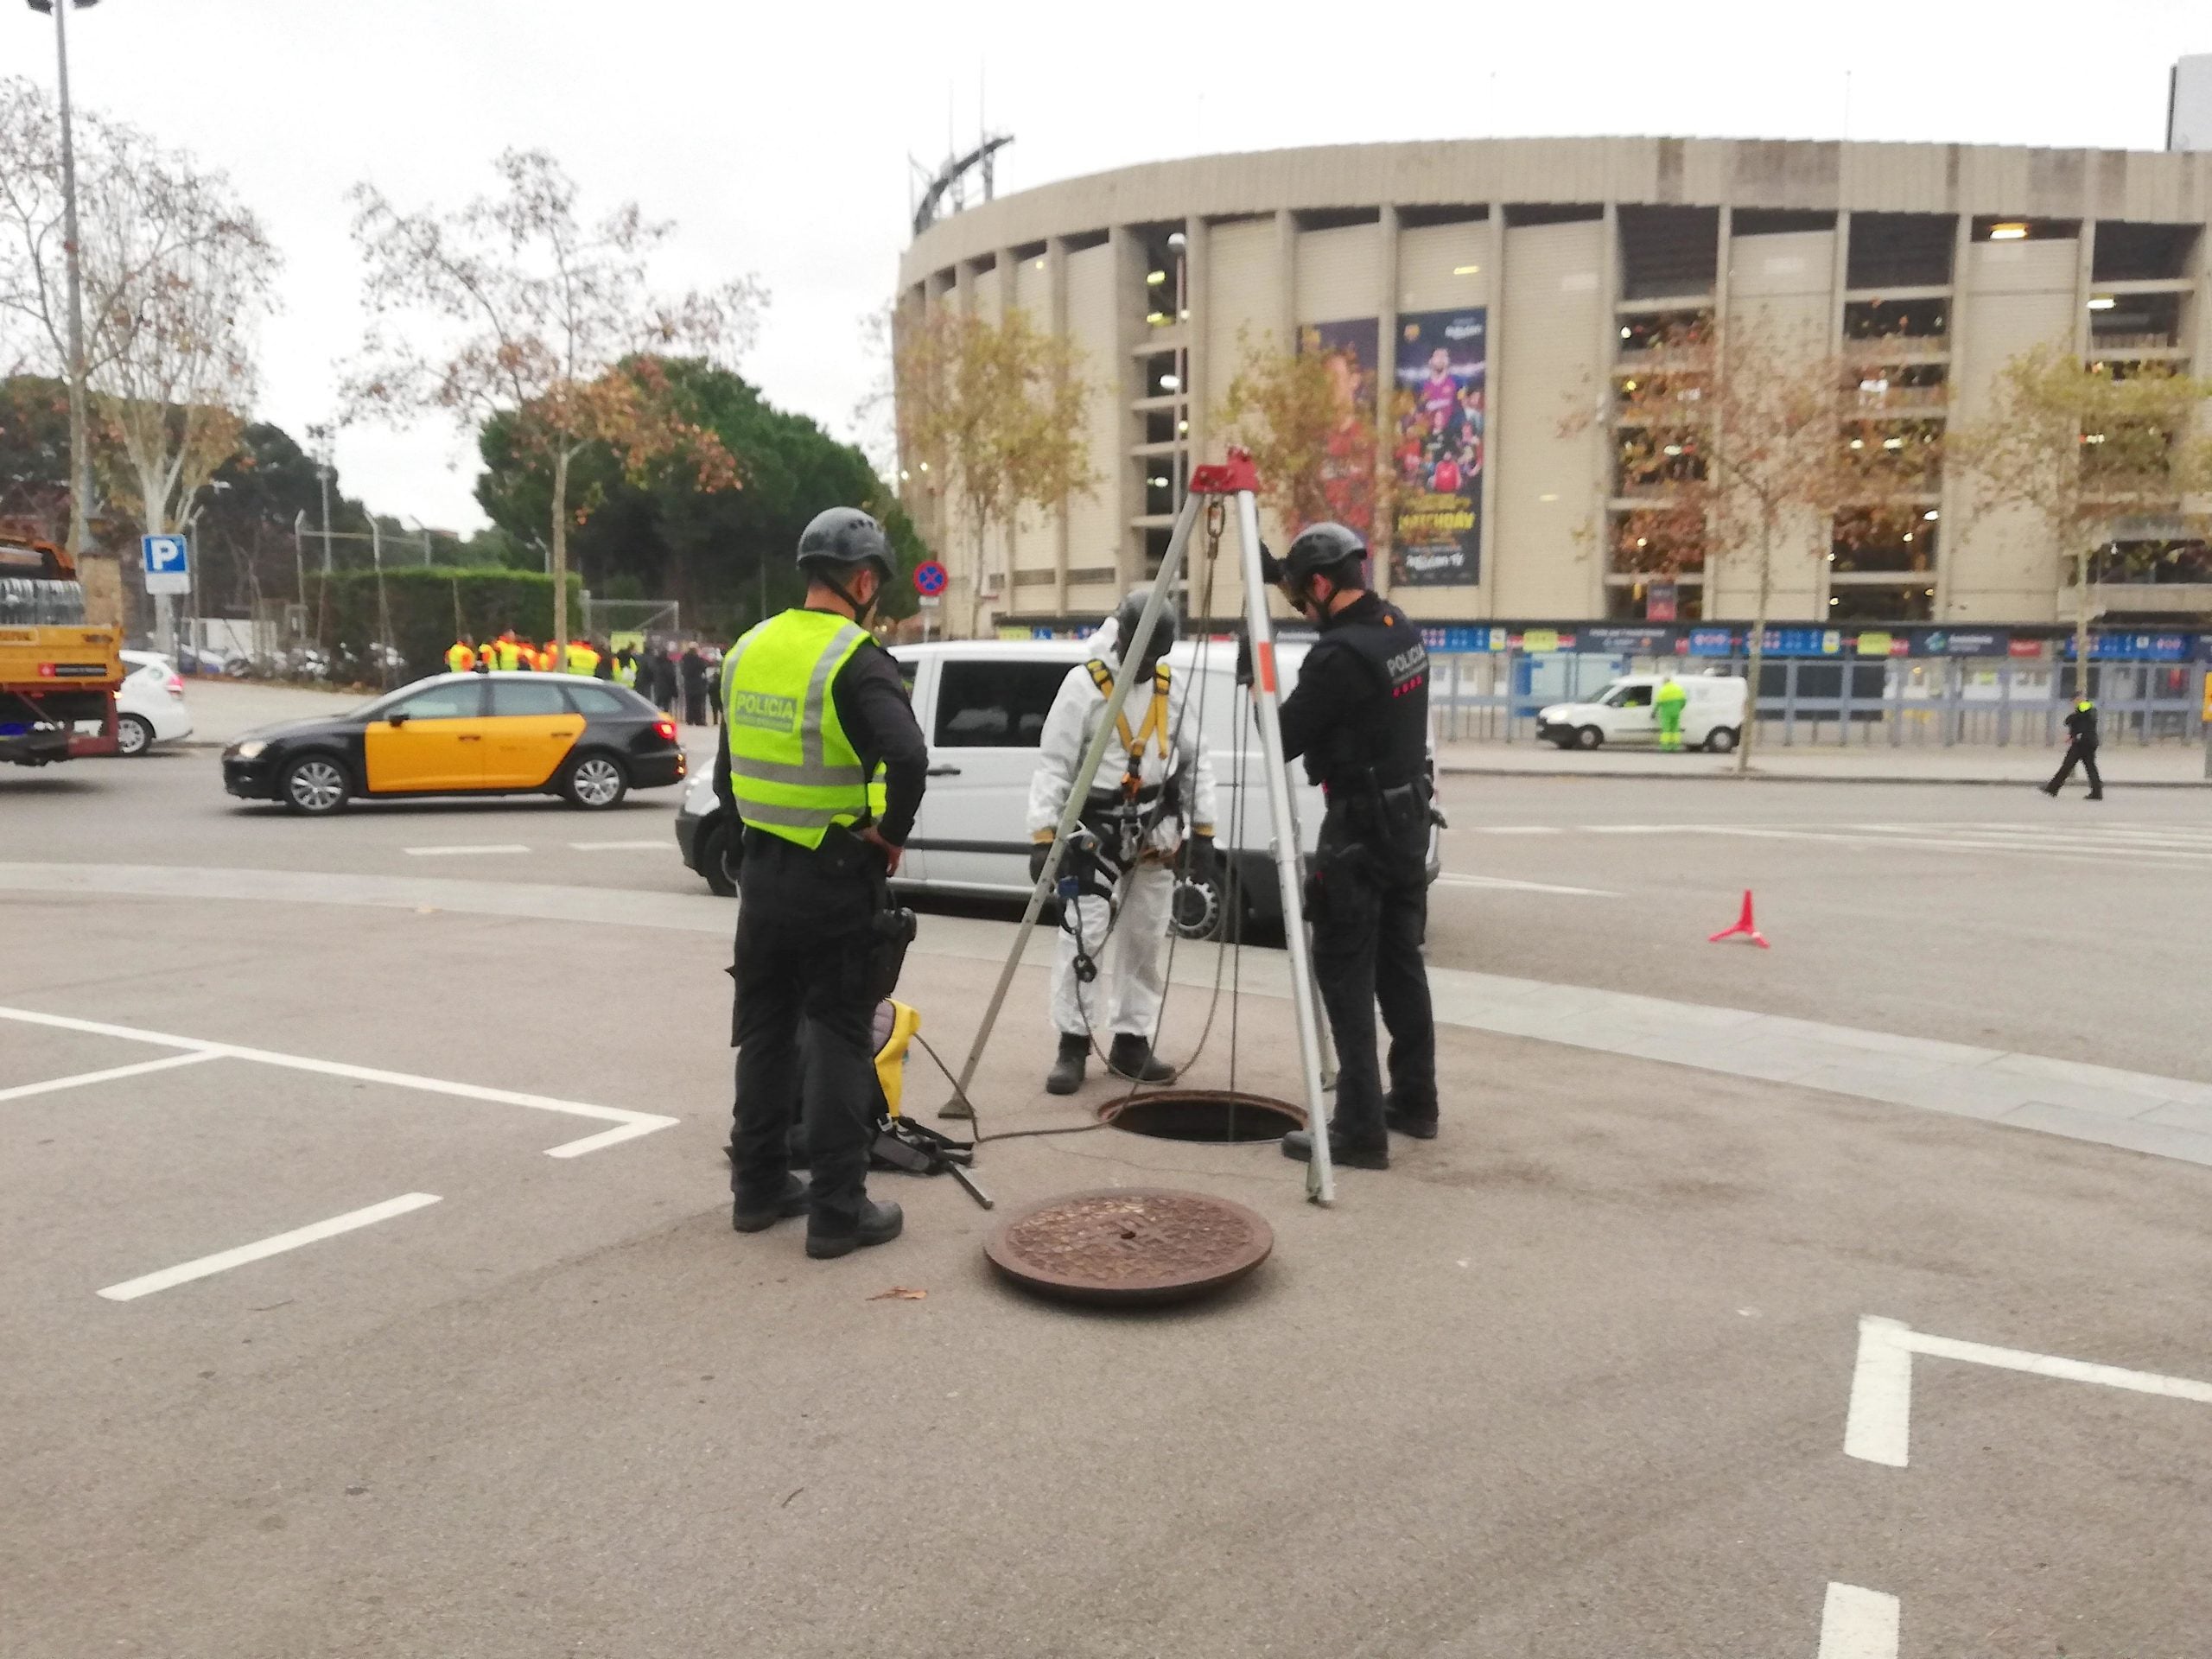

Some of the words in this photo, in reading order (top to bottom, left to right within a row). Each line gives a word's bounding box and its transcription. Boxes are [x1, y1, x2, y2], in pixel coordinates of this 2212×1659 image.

[150, 539, 179, 570] P
[1386, 643, 1426, 677] POLICIA
[736, 693, 794, 719] POLICIA
